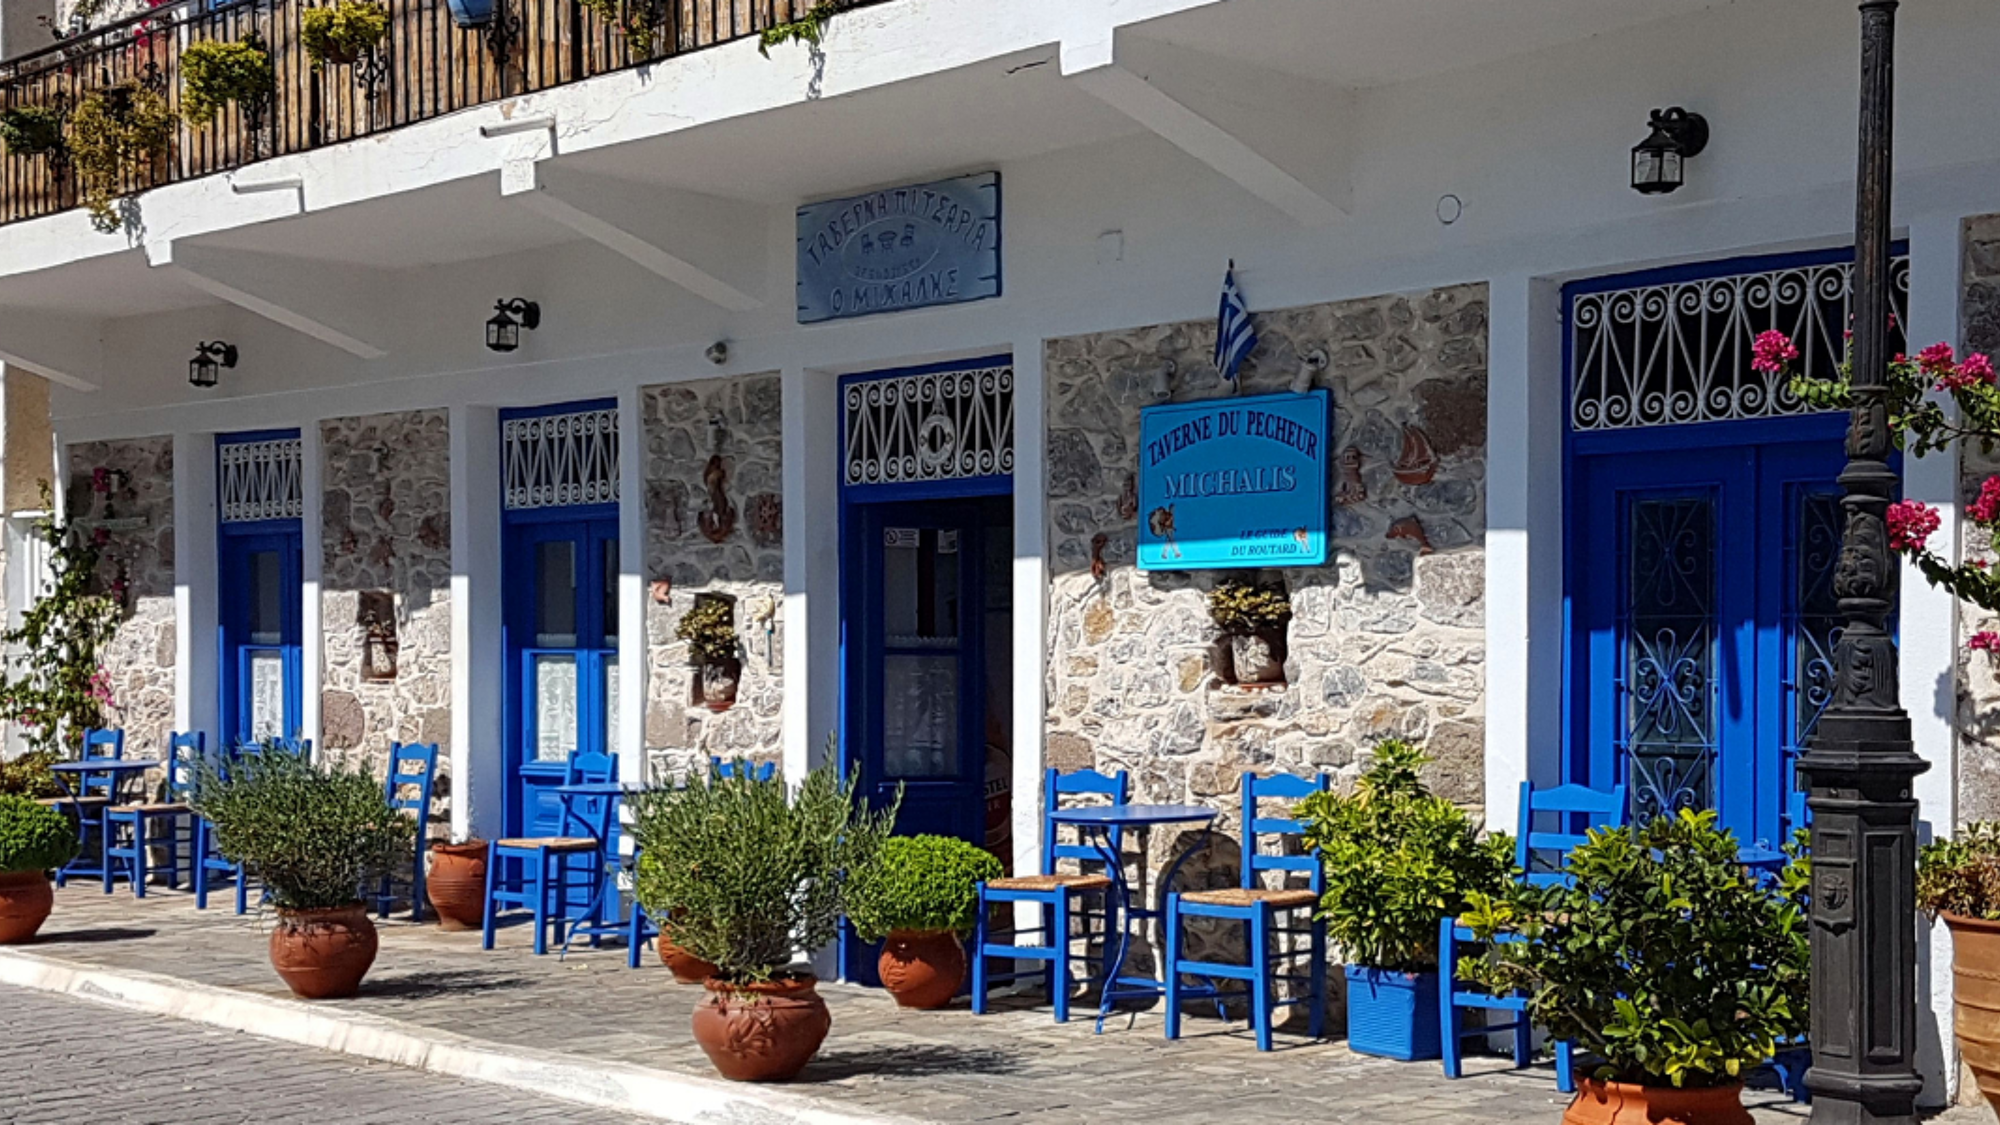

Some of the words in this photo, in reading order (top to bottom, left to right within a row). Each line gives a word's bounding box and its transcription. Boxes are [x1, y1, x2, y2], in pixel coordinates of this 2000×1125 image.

[1148, 415, 1212, 466] TAVERNE
[1218, 410, 1240, 437] DU
[1246, 410, 1318, 460] PECHEUR
[1164, 465, 1297, 499] MICHALIS
[1255, 528, 1288, 539] GUIDE
[1231, 545, 1246, 556] DU
[1247, 543, 1297, 555] ROUTARD
